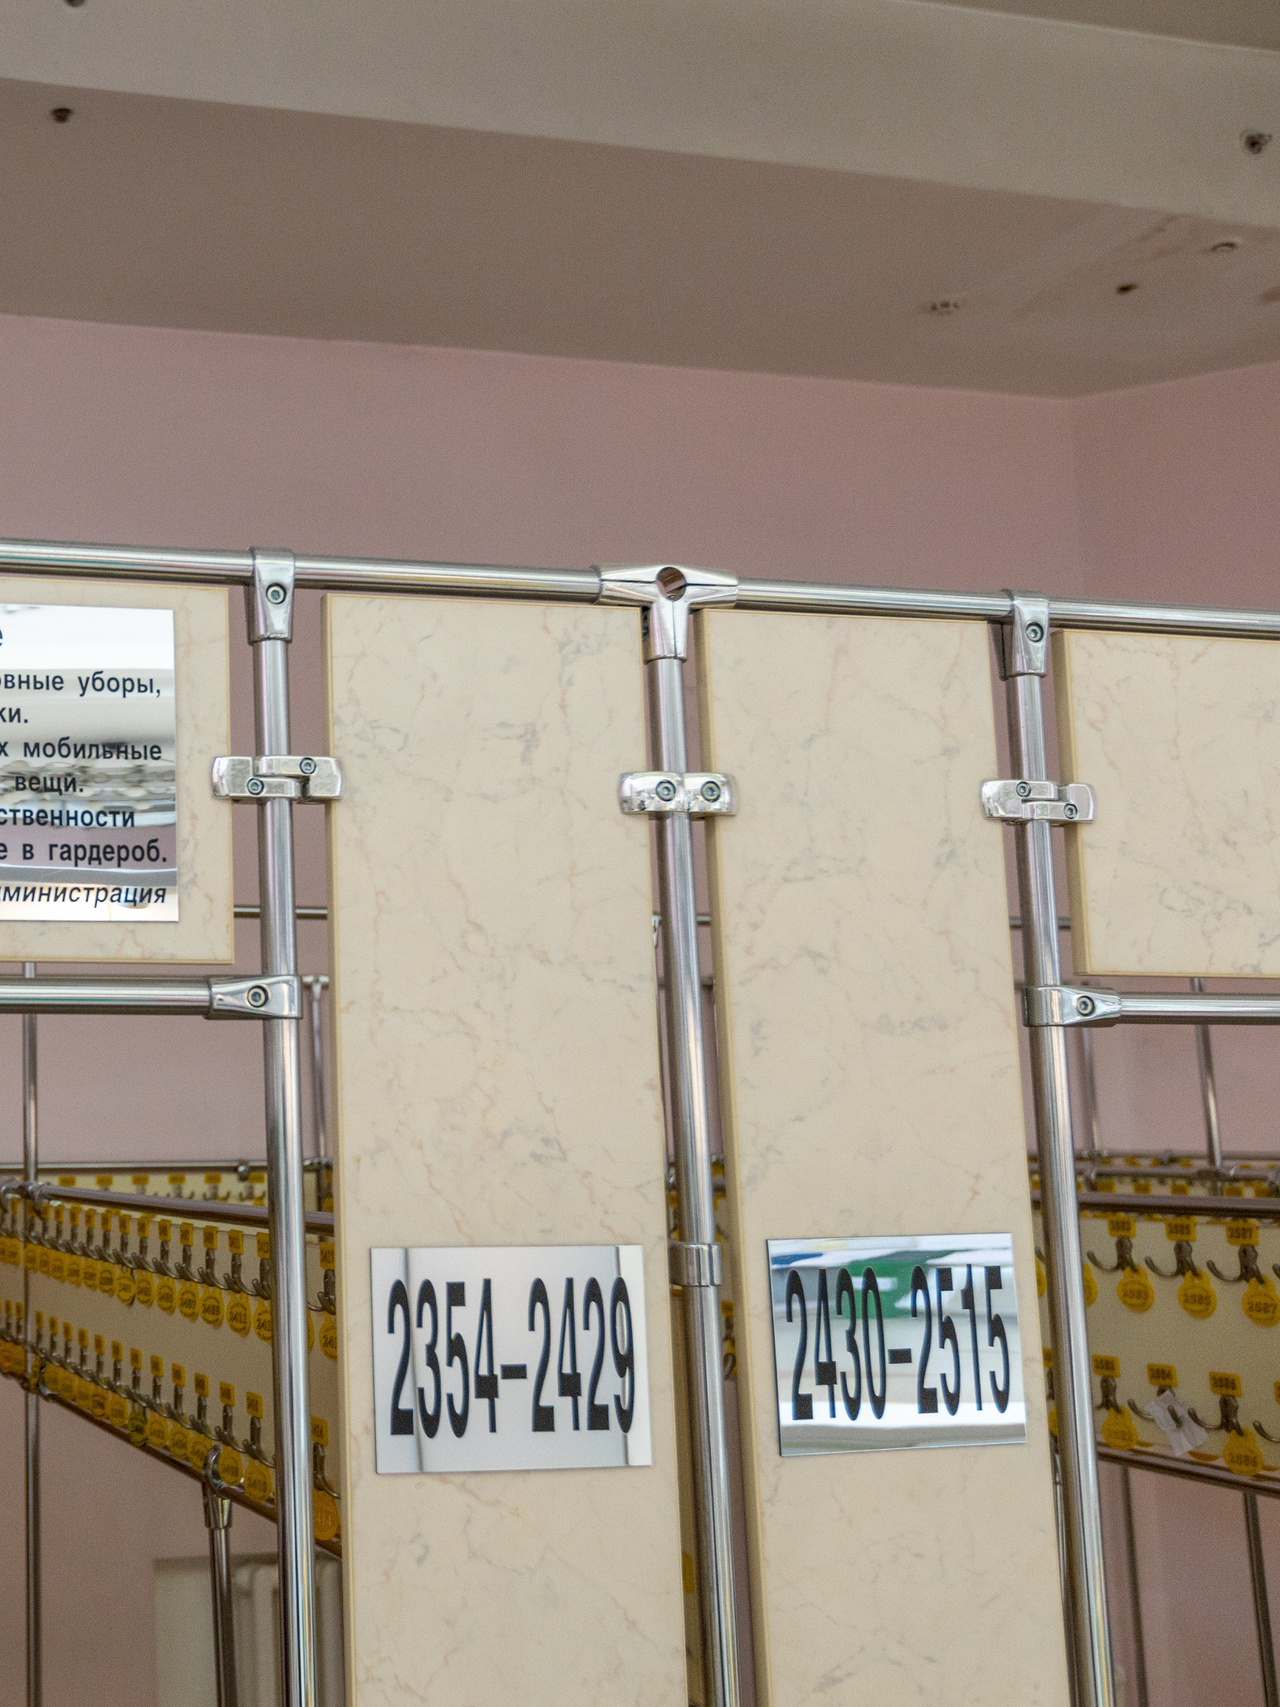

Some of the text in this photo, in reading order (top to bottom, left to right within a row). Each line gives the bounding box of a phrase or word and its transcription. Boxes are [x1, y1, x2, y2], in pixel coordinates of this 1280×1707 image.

[77, 671, 162, 699] уборы,
[23, 738, 163, 762] мобильные
[15, 773, 85, 795] вещи.
[21, 842, 35, 862] в
[48, 838, 167, 868] гардероб.
[786, 1263, 1011, 1421] 2430-2515
[387, 1276, 634, 1439] 2354-2429
